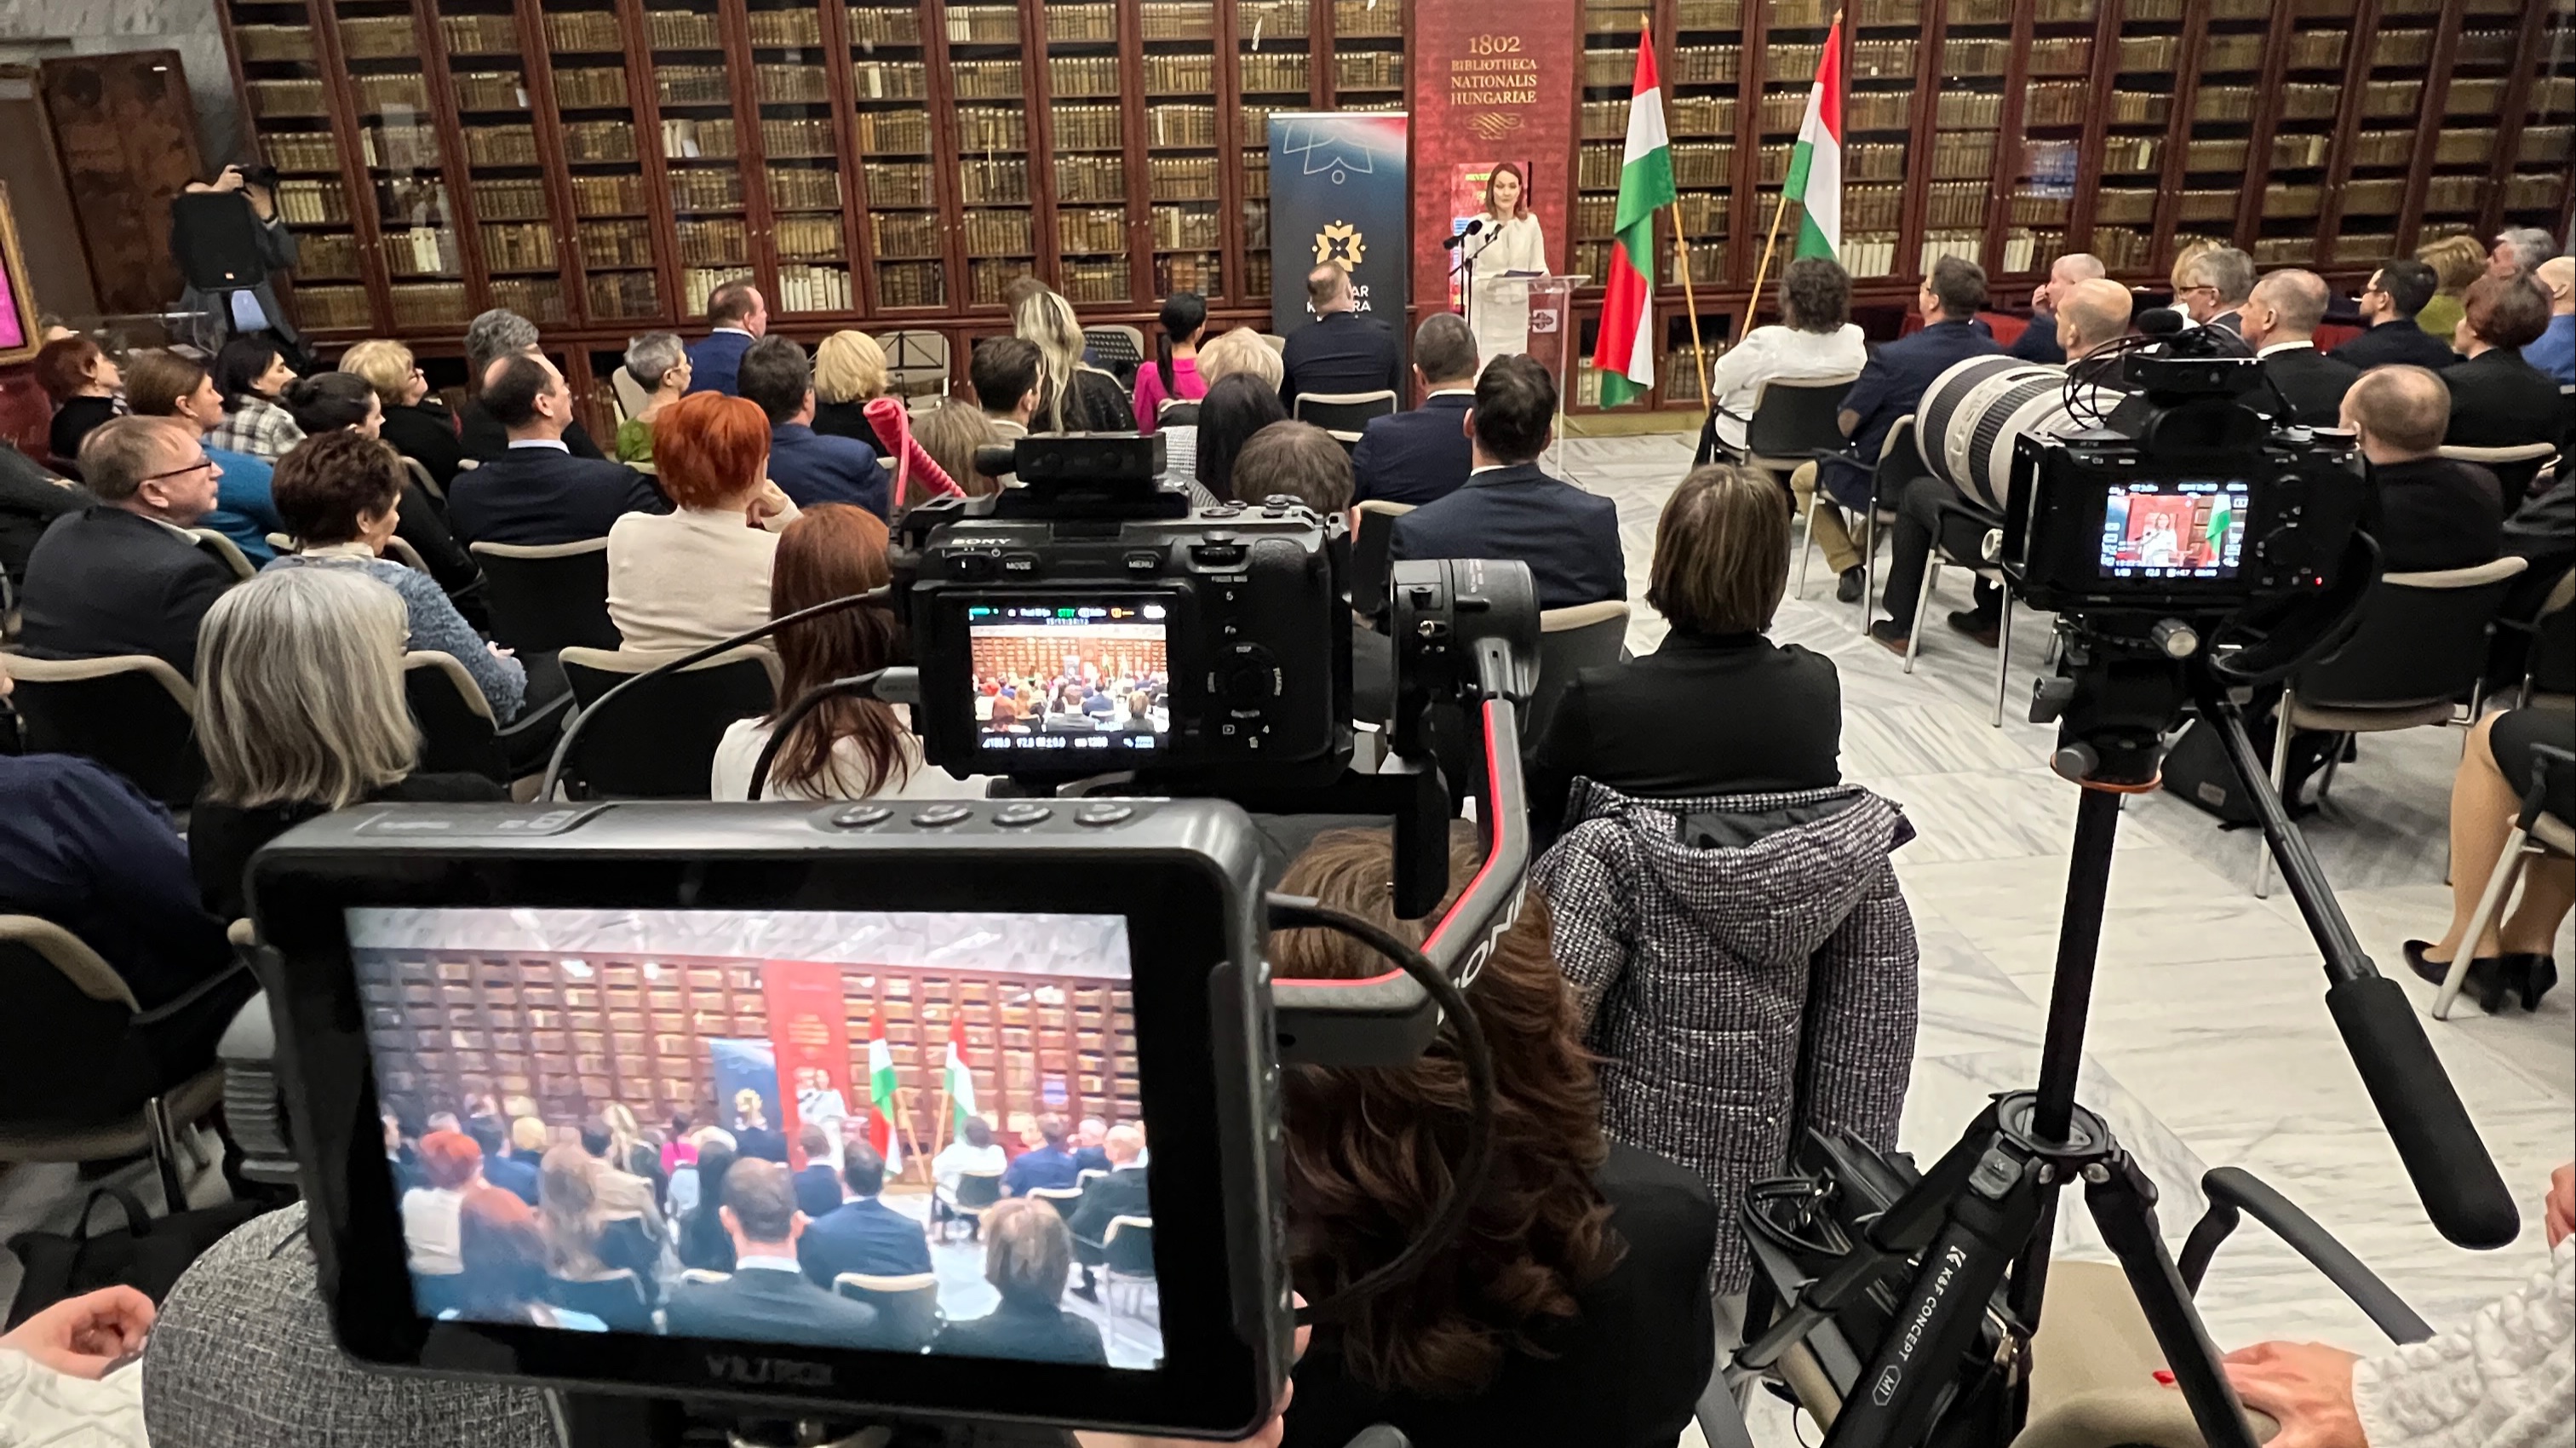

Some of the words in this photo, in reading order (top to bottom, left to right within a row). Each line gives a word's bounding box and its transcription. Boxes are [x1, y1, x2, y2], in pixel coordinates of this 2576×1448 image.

[1468, 34, 1521, 55] 1802
[1451, 59, 1537, 72] BIBLIOTHECA
[1451, 74, 1537, 89] NATIONALIS
[1451, 90, 1537, 106] HUNGARIAE
[1934, 1267, 1954, 1296] K&F
[1898, 1296, 1937, 1362] CONCEPT
